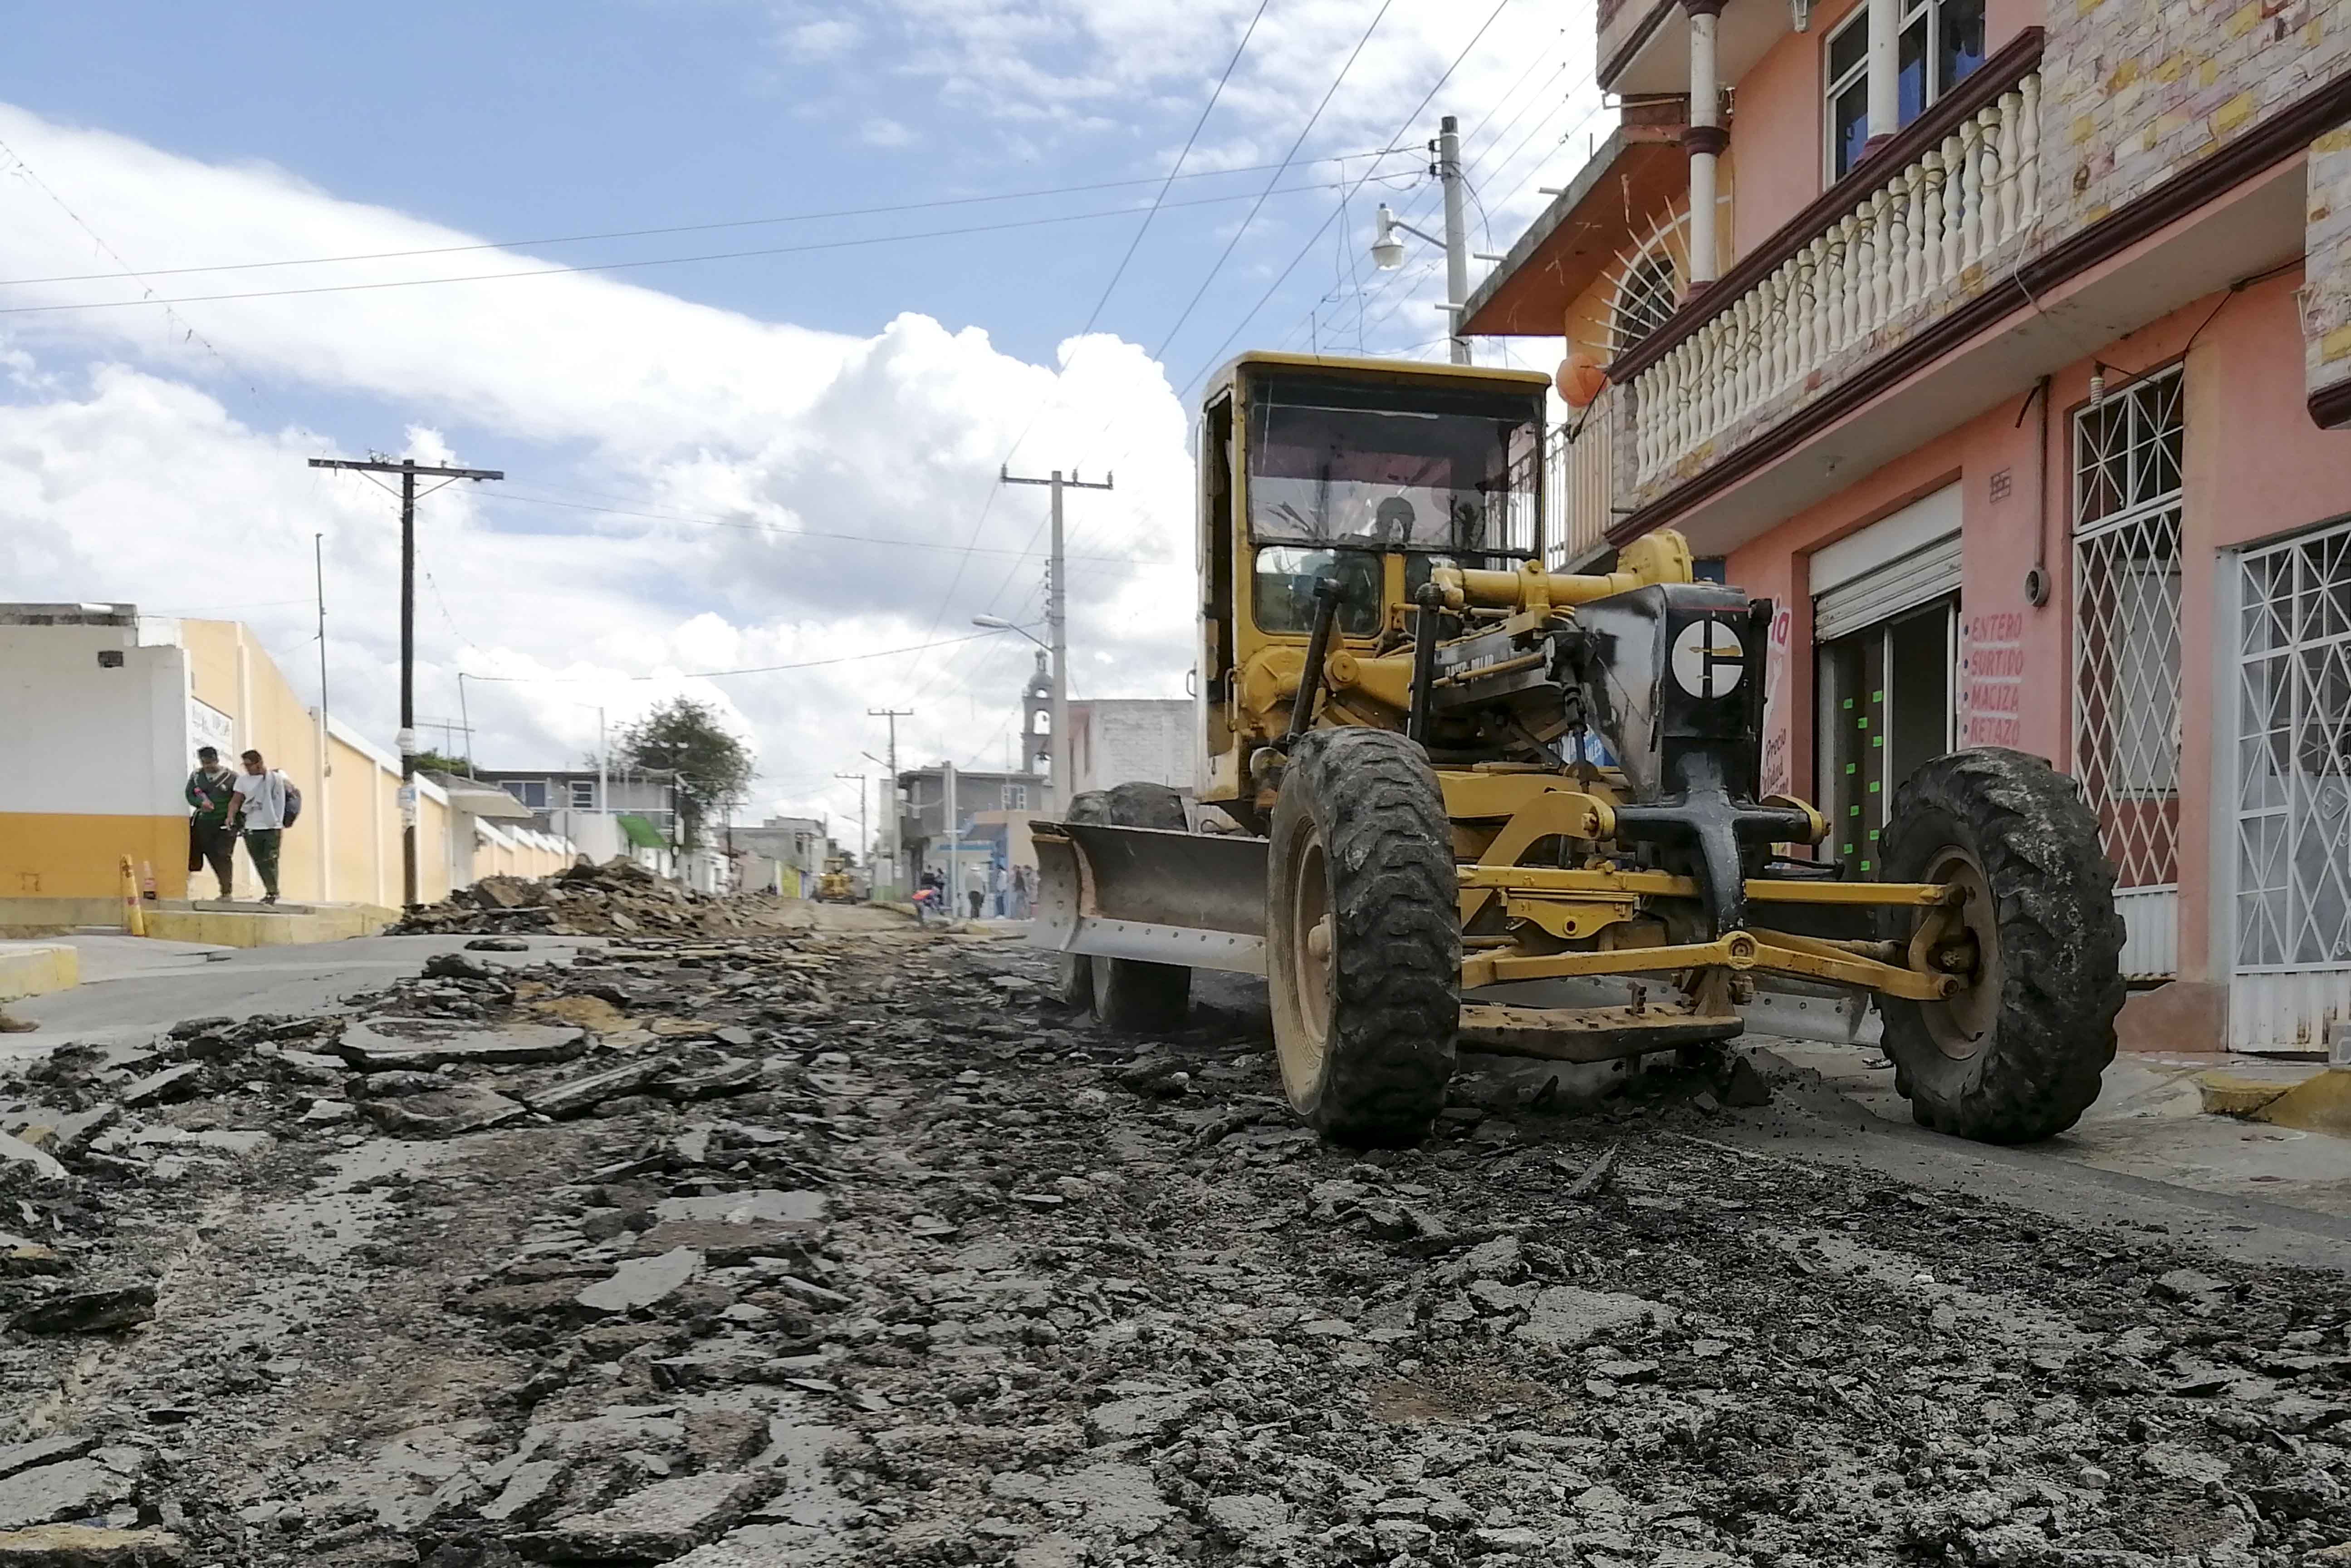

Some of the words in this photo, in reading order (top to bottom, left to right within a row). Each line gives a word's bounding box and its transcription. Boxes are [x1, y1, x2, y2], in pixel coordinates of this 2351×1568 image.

[1972, 612, 2022, 642] ENTERO
[1971, 650, 2023, 676] SURTIDO
[1971, 685, 2018, 710] MACIZA
[1970, 717, 2021, 745] RETAZO
